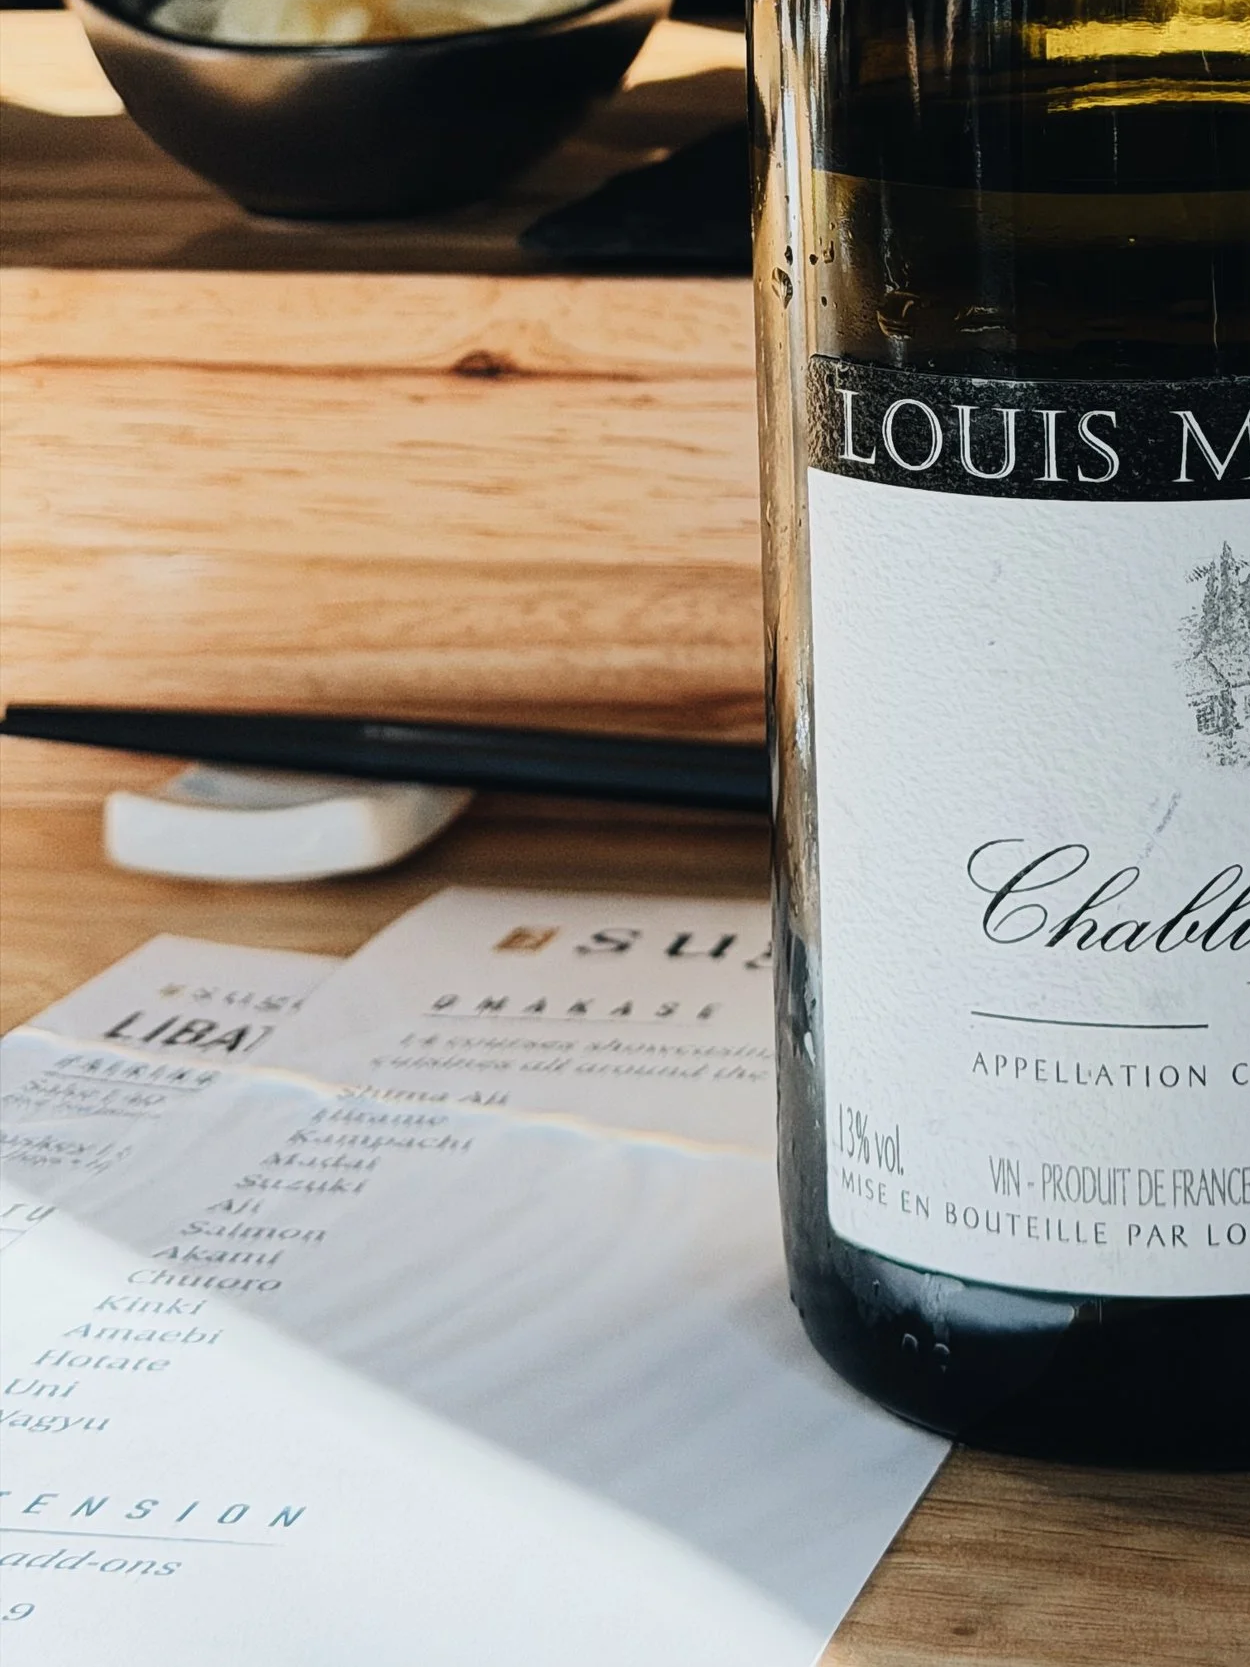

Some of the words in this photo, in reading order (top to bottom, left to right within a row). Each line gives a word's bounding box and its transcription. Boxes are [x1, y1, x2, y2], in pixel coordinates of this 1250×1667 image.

[835, 388, 1121, 483] LOUIS
[430, 992, 722, 1020] OMAKASE
[971, 1051, 1208, 1089] APPELLATION
[838, 1103, 871, 1166] 13%
[875, 1124, 905, 1177] vol.
[233, 1173, 368, 1195] Suzuki
[988, 1154, 1021, 1198] VIN
[1041, 1162, 1131, 1206] PRODUIT
[1137, 1168, 1166, 1207] DE
[206, 1197, 264, 1215] Aji
[840, 1166, 889, 1206] MISE
[901, 1190, 930, 1220] EN
[945, 1201, 1108, 1246] BOUTEILLE
[1128, 1222, 1188, 1248] PAR
[180, 1220, 329, 1243] Salmon
[151, 1244, 286, 1267] Akami
[127, 1268, 283, 1292] Chutoro
[94, 1294, 208, 1316] Kinki
[62, 1322, 225, 1345] Amaebi
[31, 1348, 172, 1373] Hotate
[2, 1377, 81, 1399] Uni
[0, 1490, 307, 1529] ENSION
[0, 1548, 182, 1577] add-ons
